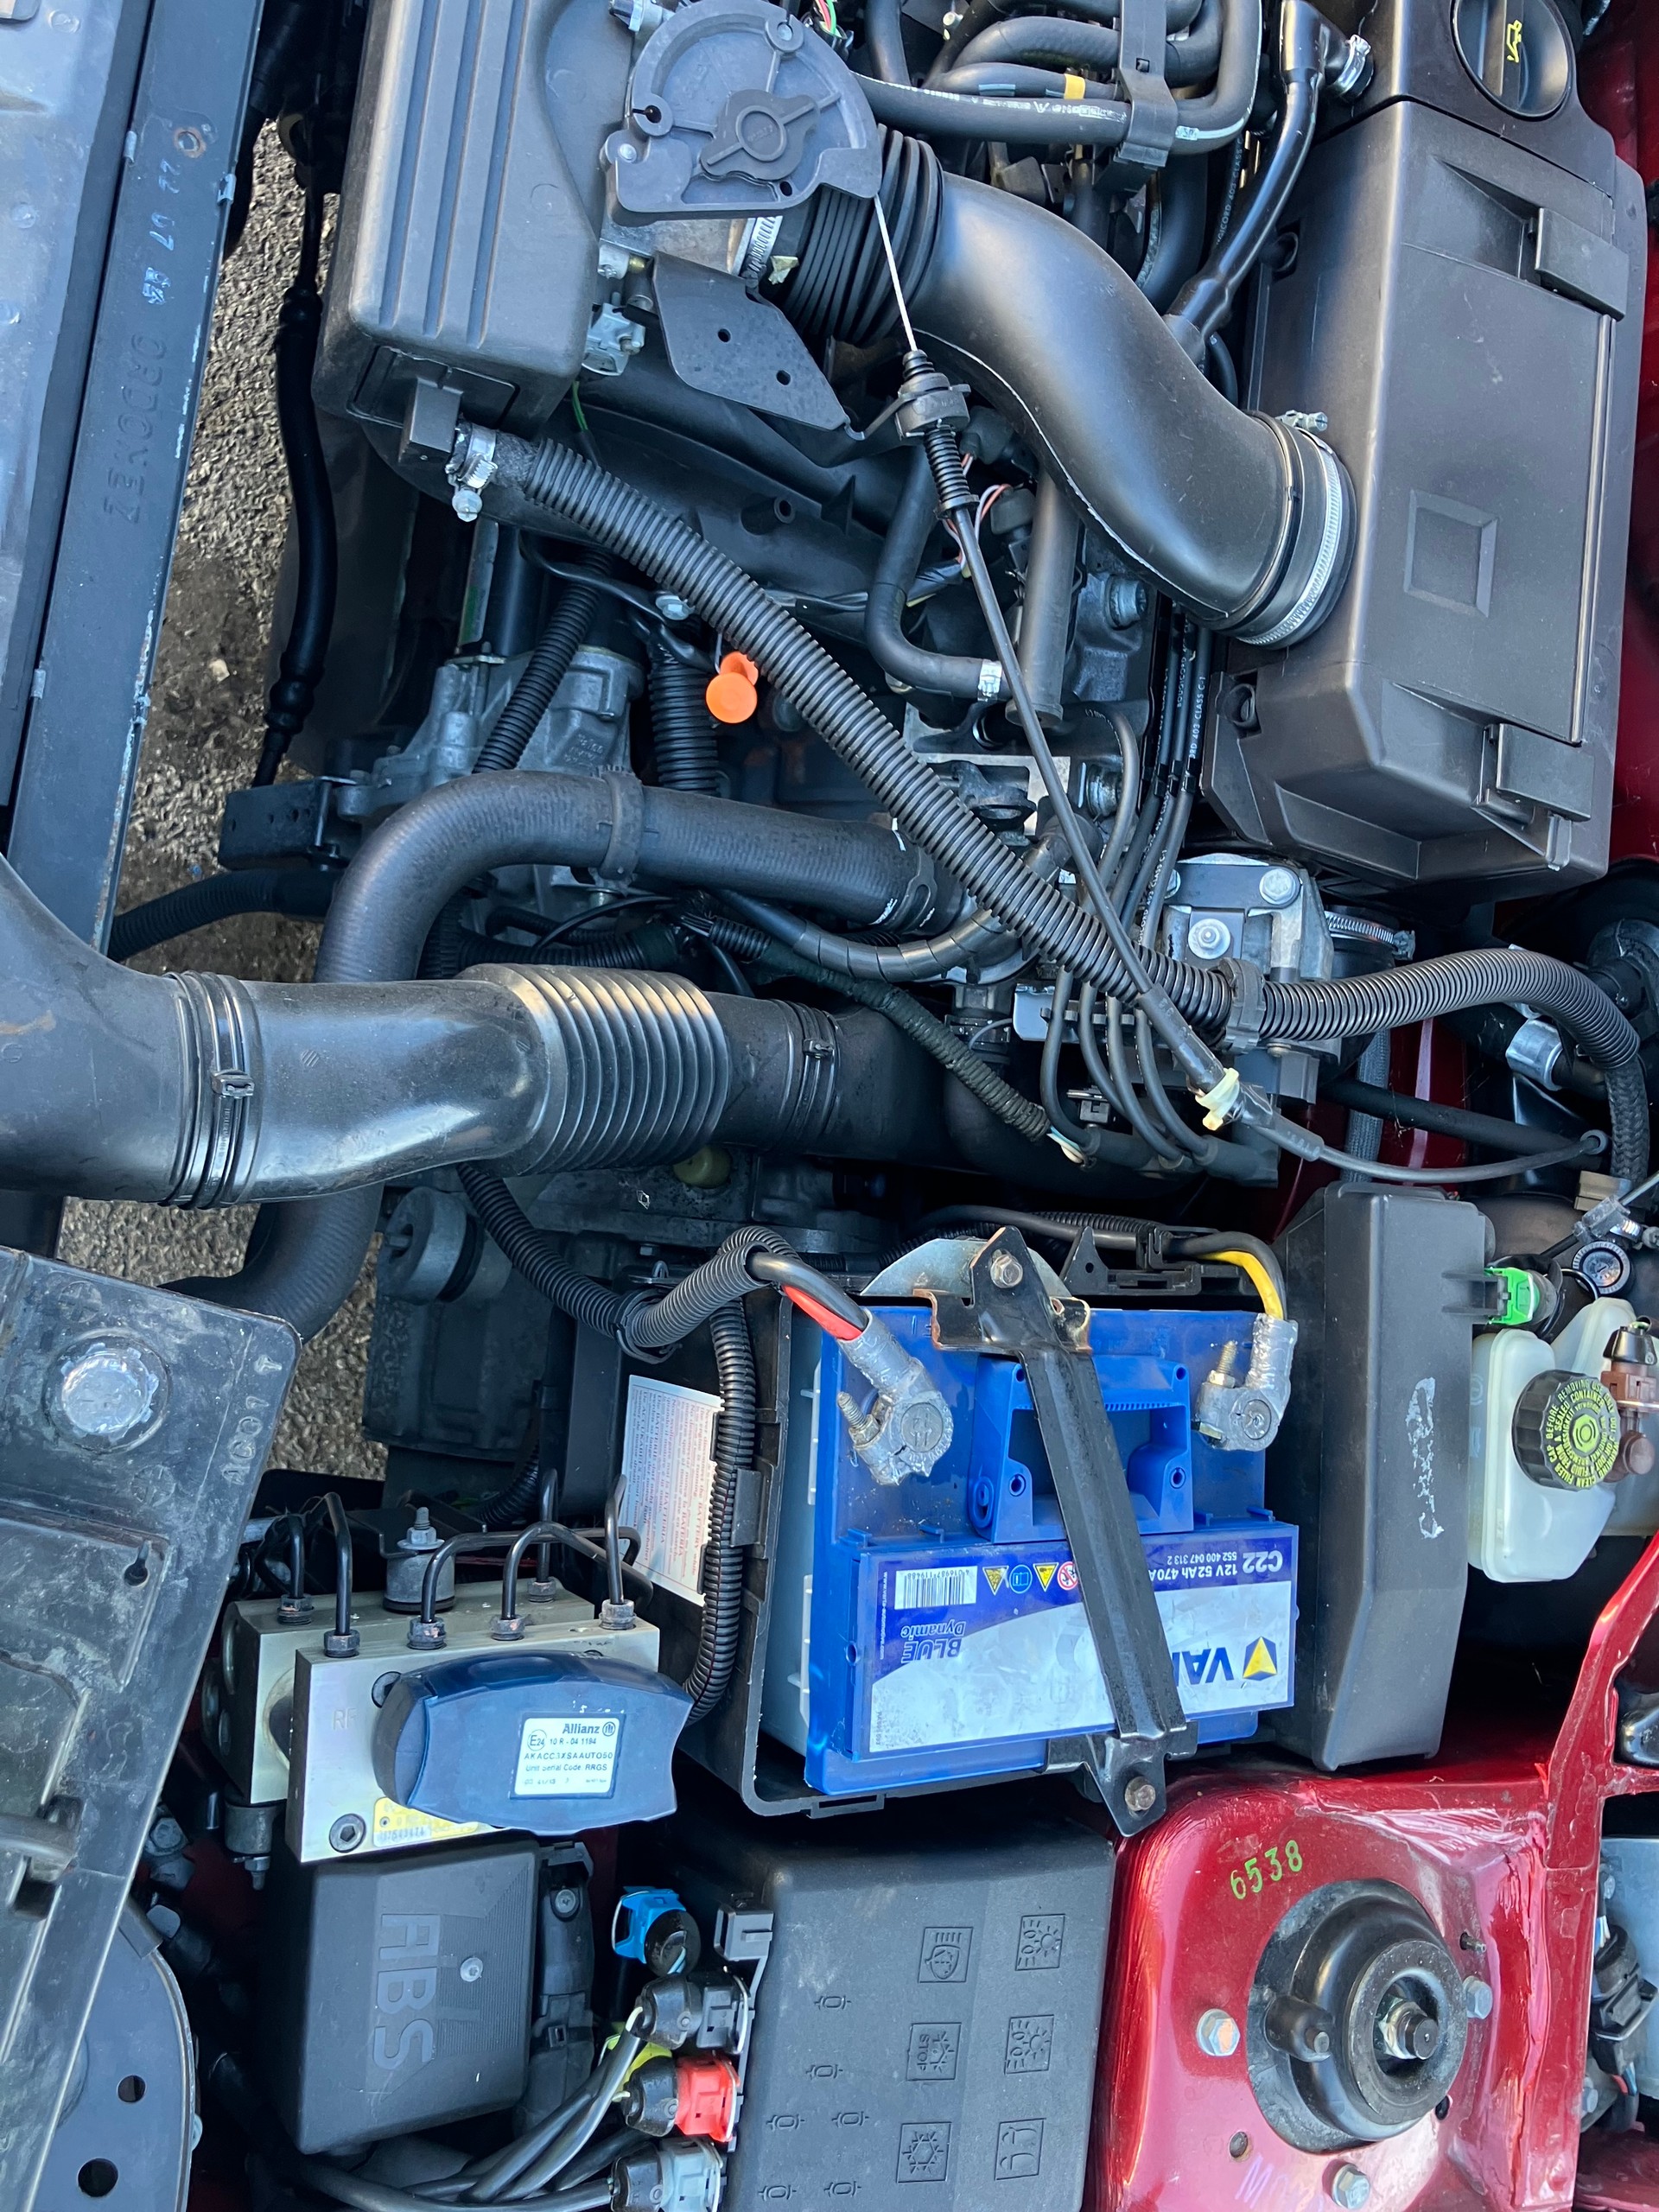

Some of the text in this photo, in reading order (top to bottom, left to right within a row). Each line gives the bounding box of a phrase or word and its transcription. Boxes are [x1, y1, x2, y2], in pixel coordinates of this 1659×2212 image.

[1195, 693, 1204, 719] CLASS
[1192, 724, 1200, 739] 403
[1558, 1379, 1589, 1402] REMOVING
[1570, 1390, 1605, 1407] CONTAINER
[1592, 1381, 1603, 1395] USE
[1546, 1404, 1559, 1439] BEFORE
[1554, 1401, 1570, 1431] SEALED
[1547, 1445, 1557, 1463] CAP
[1555, 1444, 1571, 1469] FROM
[1554, 1463, 1574, 1484] FILLER
[1571, 1464, 1589, 1477] FLUID
[1576, 1477, 1596, 1487] CLEAN
[1167, 1552, 1237, 1565] 552 400 047 313 2
[1243, 1550, 1283, 1573] C22
[1182, 1567, 1212, 1579] 52Ah
[1216, 1565, 1237, 1576] 12V
[900, 1618, 966, 1640] Dynamic
[901, 1637, 962, 1663] BLUE
[563, 1724, 600, 1733] Allianz
[1230, 1839, 1304, 1901] 6538
[371, 1913, 440, 2072] ABS
